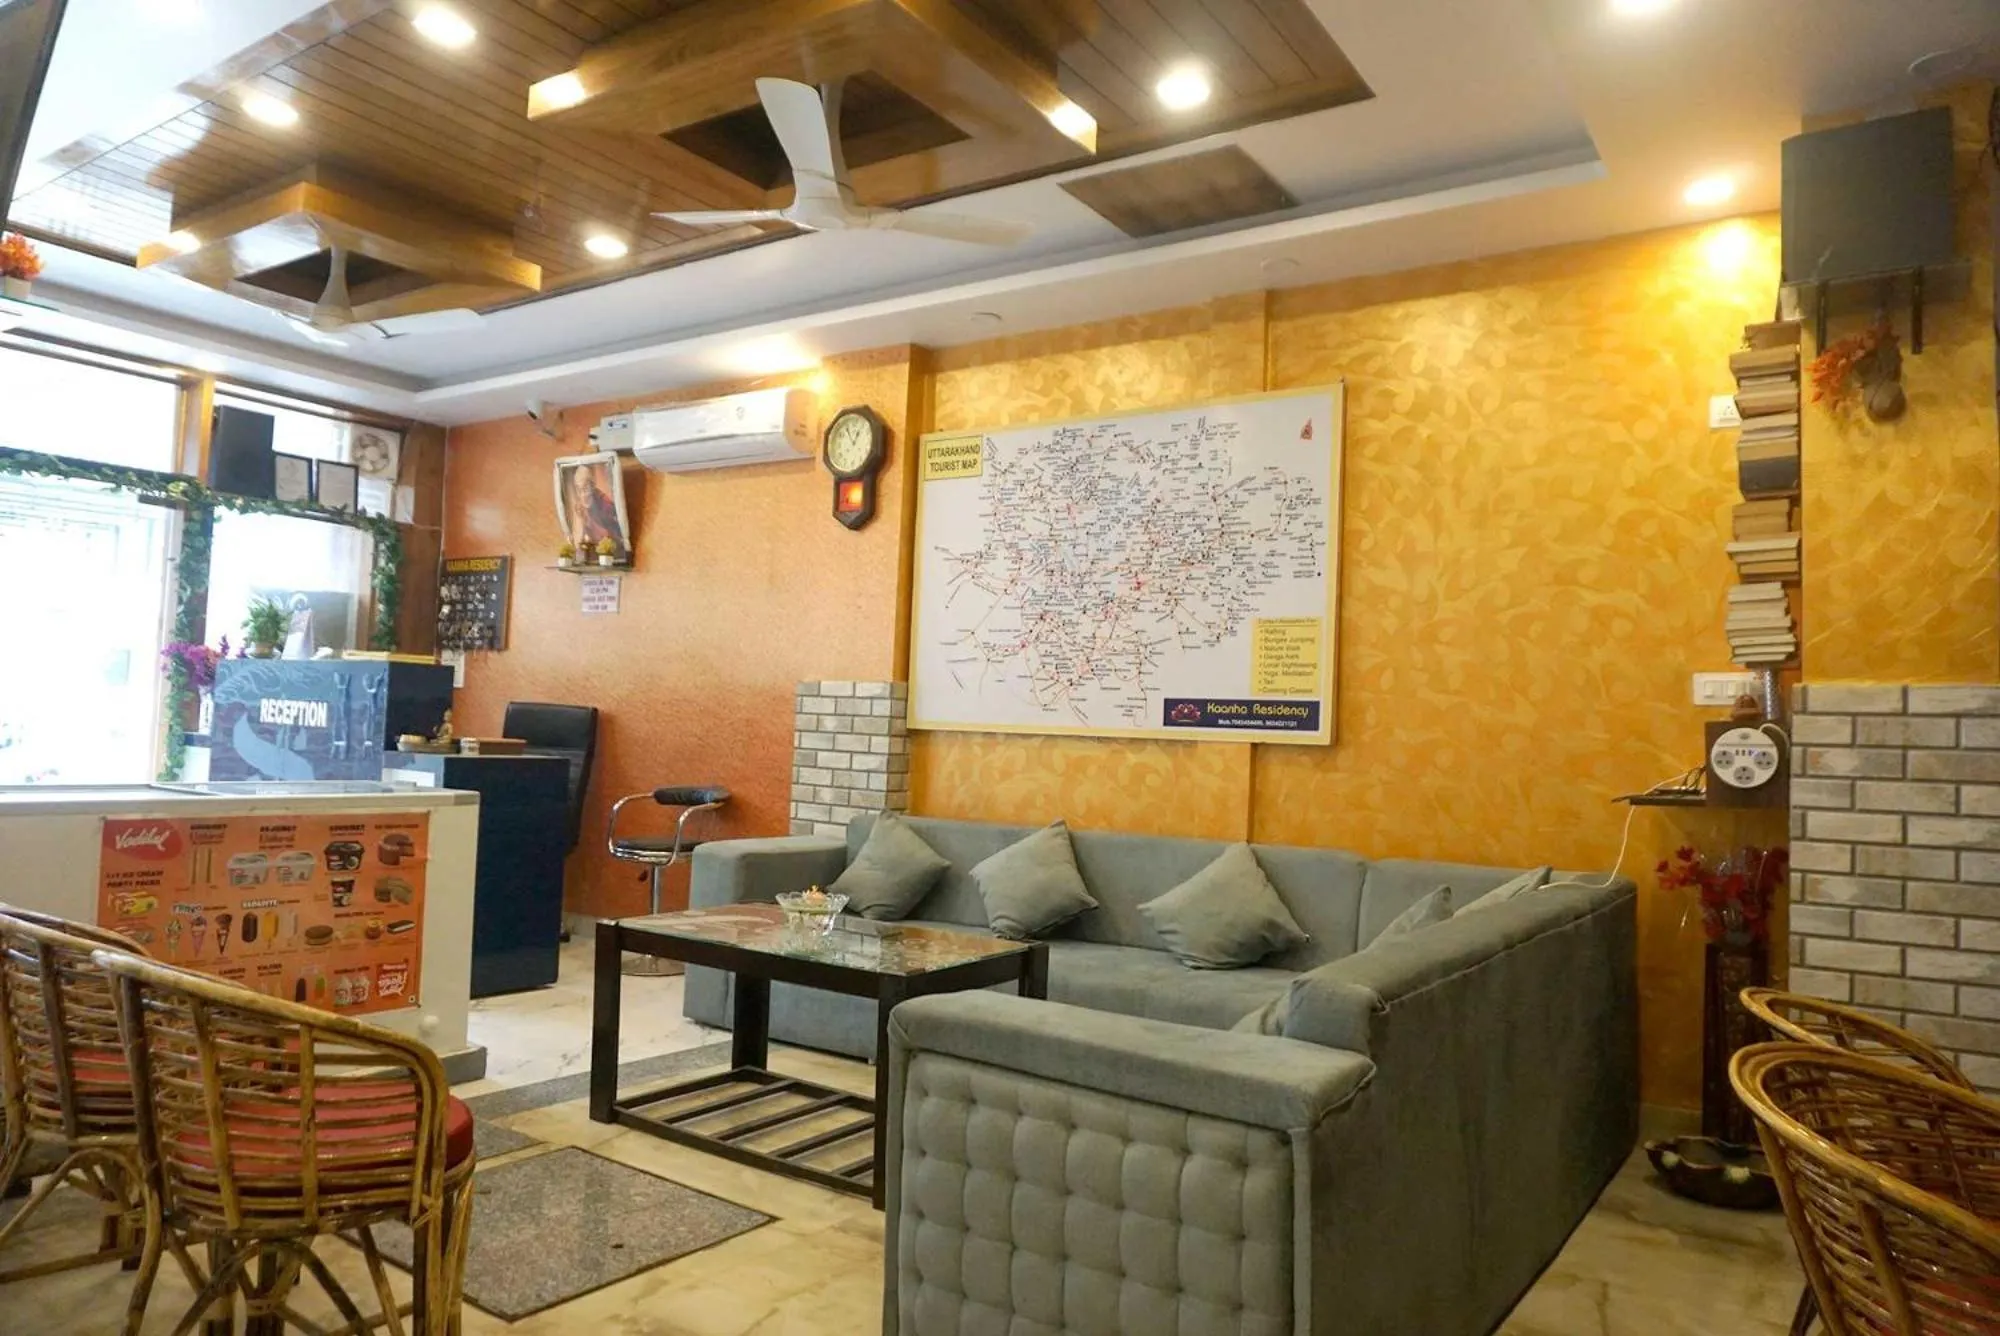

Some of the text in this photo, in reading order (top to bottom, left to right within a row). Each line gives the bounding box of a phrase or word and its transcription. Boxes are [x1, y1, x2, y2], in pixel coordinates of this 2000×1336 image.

[927, 444, 981, 459] UTTARAKHAND
[930, 458, 978, 472] TOURIST MAP
[259, 699, 328, 727] RECEPTION
[1253, 703, 1309, 719] Residency
